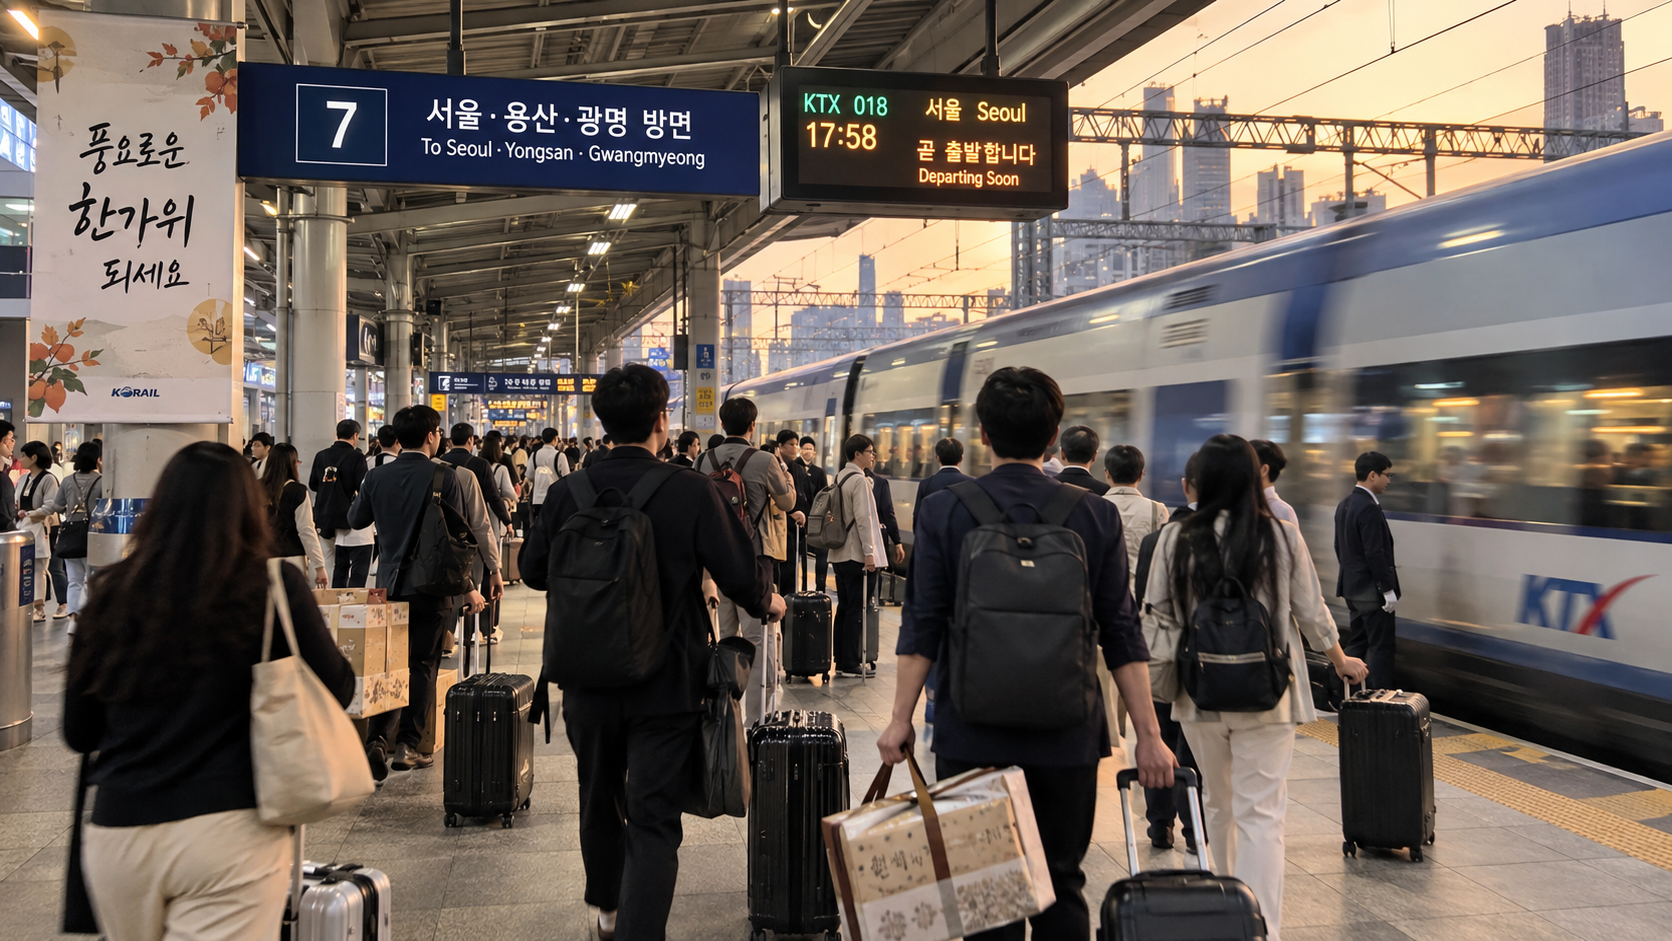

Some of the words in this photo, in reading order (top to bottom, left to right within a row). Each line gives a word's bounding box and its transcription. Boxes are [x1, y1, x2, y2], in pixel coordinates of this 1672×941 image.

[804, 92, 841, 115] KTX
[853, 95, 889, 117] 018
[925, 97, 963, 122] 서울
[976, 101, 1027, 123] Seoul
[327, 100, 357, 149] 7
[643, 109, 691, 140] 방면
[806, 121, 878, 151] 17:58
[79, 122, 186, 175] 풍요로운
[421, 137, 442, 155] To
[447, 138, 493, 158] Seoul
[505, 141, 573, 164] Yongsan
[588, 144, 706, 170] Gwangmyeong
[916, 139, 936, 162] 곧
[944, 140, 1037, 166] 출발합니다
[918, 167, 984, 189] Departing
[986, 170, 1020, 187] Soon
[68, 181, 195, 249] 한가위
[100, 258, 190, 294] 되세요
[111, 386, 160, 398] KORAIL
[1515, 573, 1658, 640] KTX
